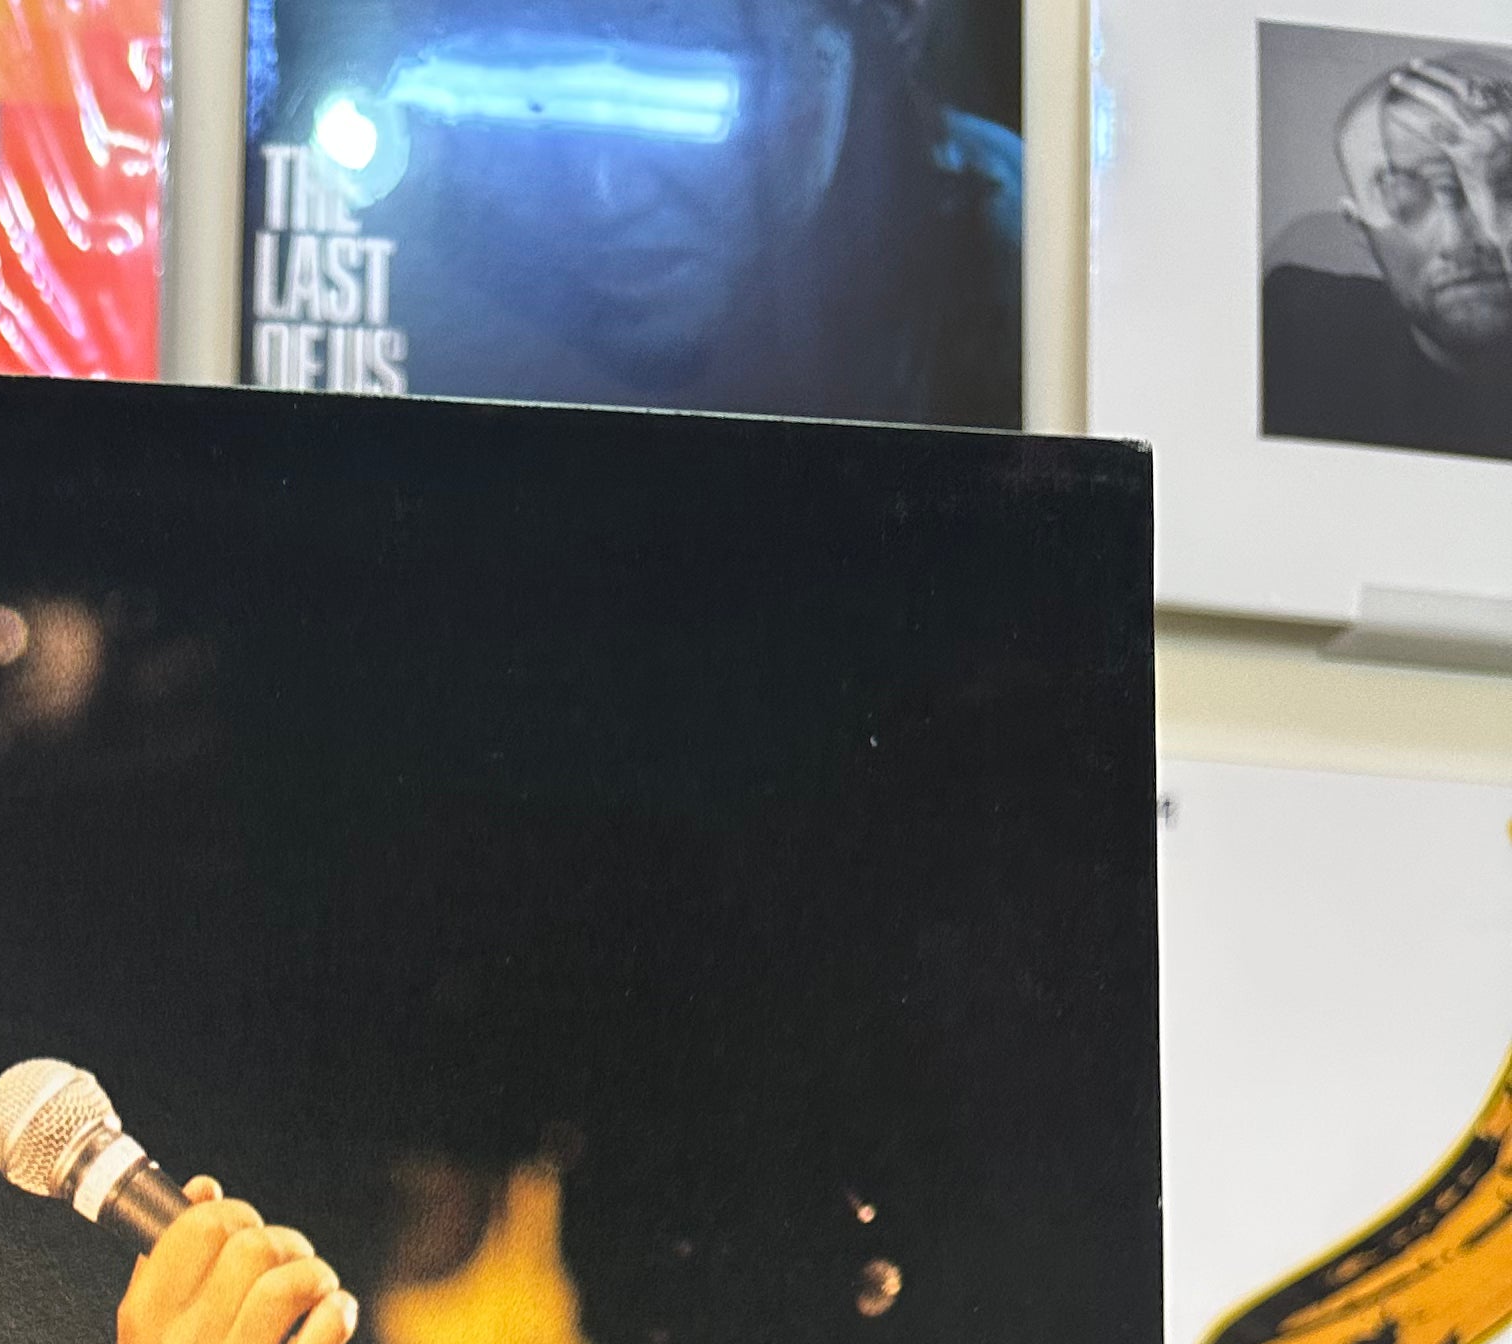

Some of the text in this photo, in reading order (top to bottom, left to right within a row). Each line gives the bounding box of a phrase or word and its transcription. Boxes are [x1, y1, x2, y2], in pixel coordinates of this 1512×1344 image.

[254, 231, 398, 325] LAST
[253, 321, 409, 396] OF US
